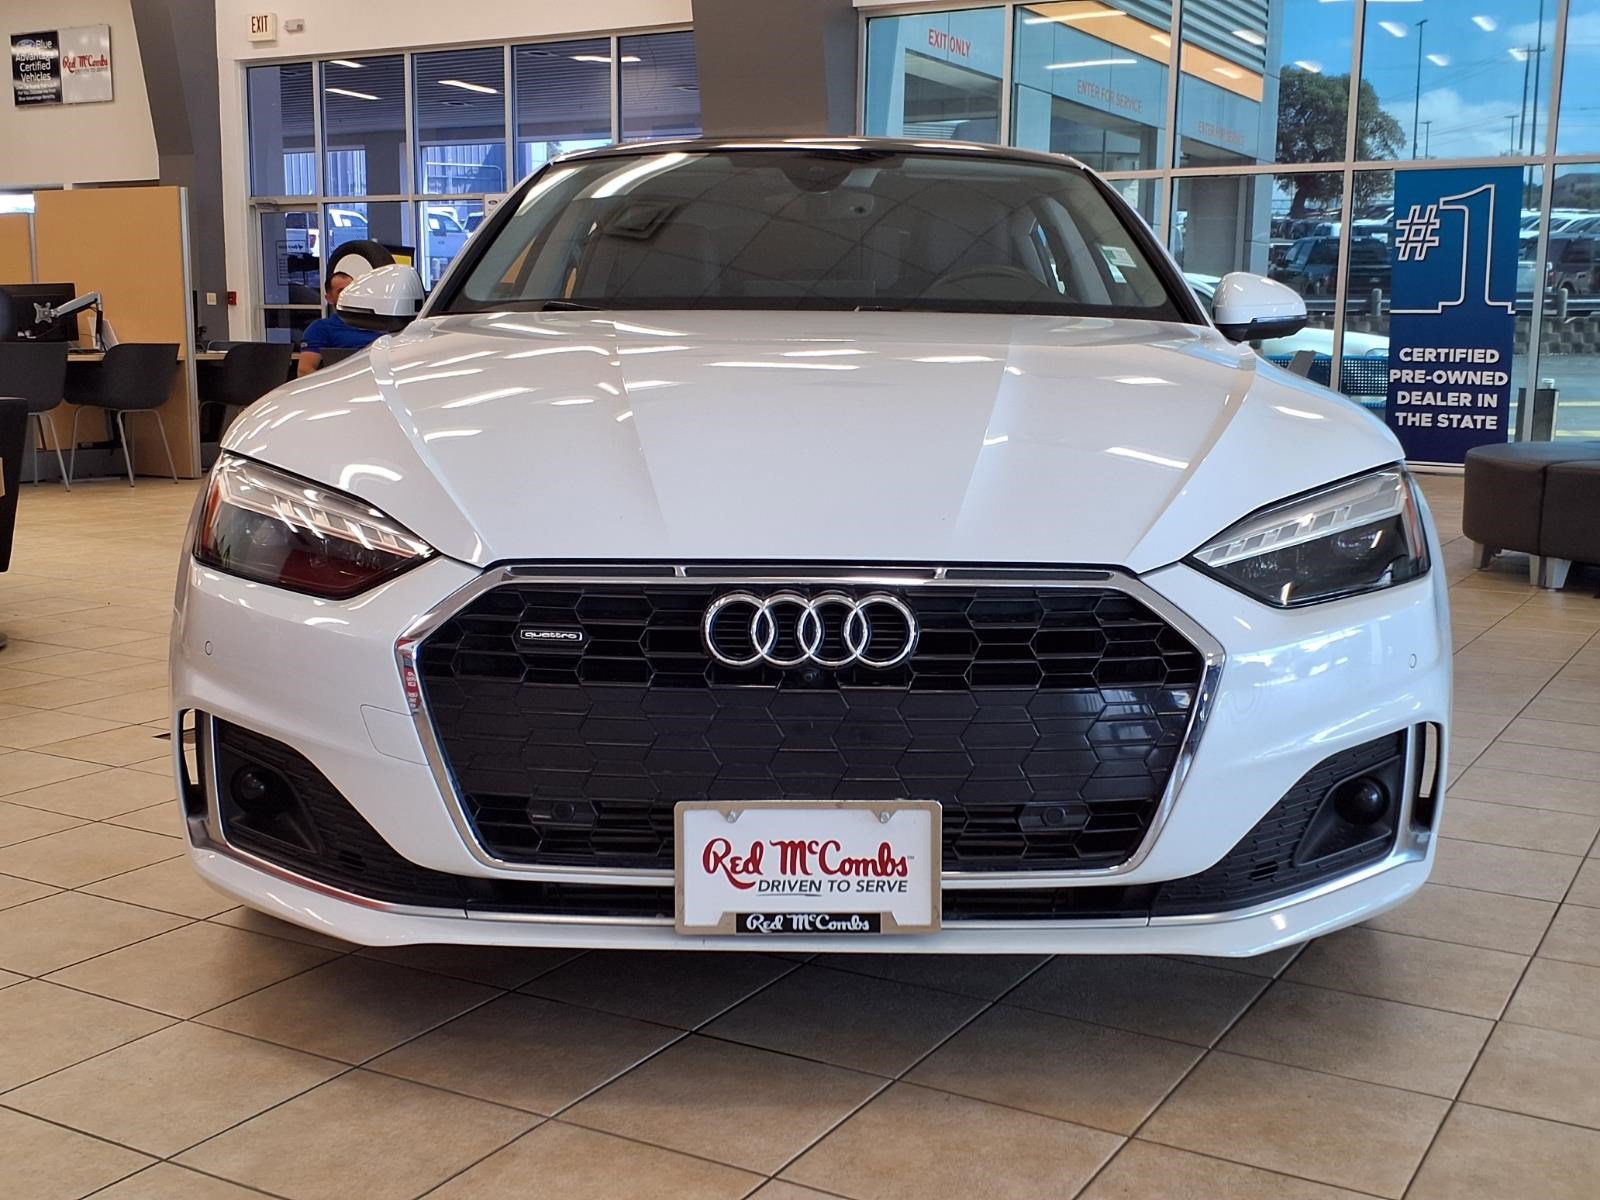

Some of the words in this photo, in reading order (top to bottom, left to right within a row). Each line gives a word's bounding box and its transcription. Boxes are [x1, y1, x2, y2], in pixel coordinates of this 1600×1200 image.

[251, 15, 268, 33] EXIT
[36, 40, 53, 49] Blue
[928, 28, 947, 50] EXIT
[950, 35, 971, 57] ONLY
[20, 61, 51, 72] Certified
[63, 55, 76, 72] Red
[77, 53, 108, 68] McCombs
[21, 73, 51, 83] Vehicles
[1077, 79, 1100, 98] ENTER
[1101, 87, 1115, 104] FOR
[1116, 92, 1143, 113] SERVICE
[1391, 184, 1516, 314] #1
[1399, 347, 1500, 364] CERTIFIED
[1389, 369, 1509, 386] PRE-OWNED
[1397, 391, 1472, 407] DEALER
[1477, 393, 1498, 408] IN
[1395, 412, 1433, 427] THE
[1437, 413, 1498, 430] STATE
[702, 838, 764, 890] Red
[769, 840, 908, 877] McCombs
[758, 879, 822, 893] DRIVEN
[827, 879, 851, 893] TO
[856, 879, 908, 893] SERVE
[746, 914, 784, 933] Red
[786, 913, 870, 931] McCombs
